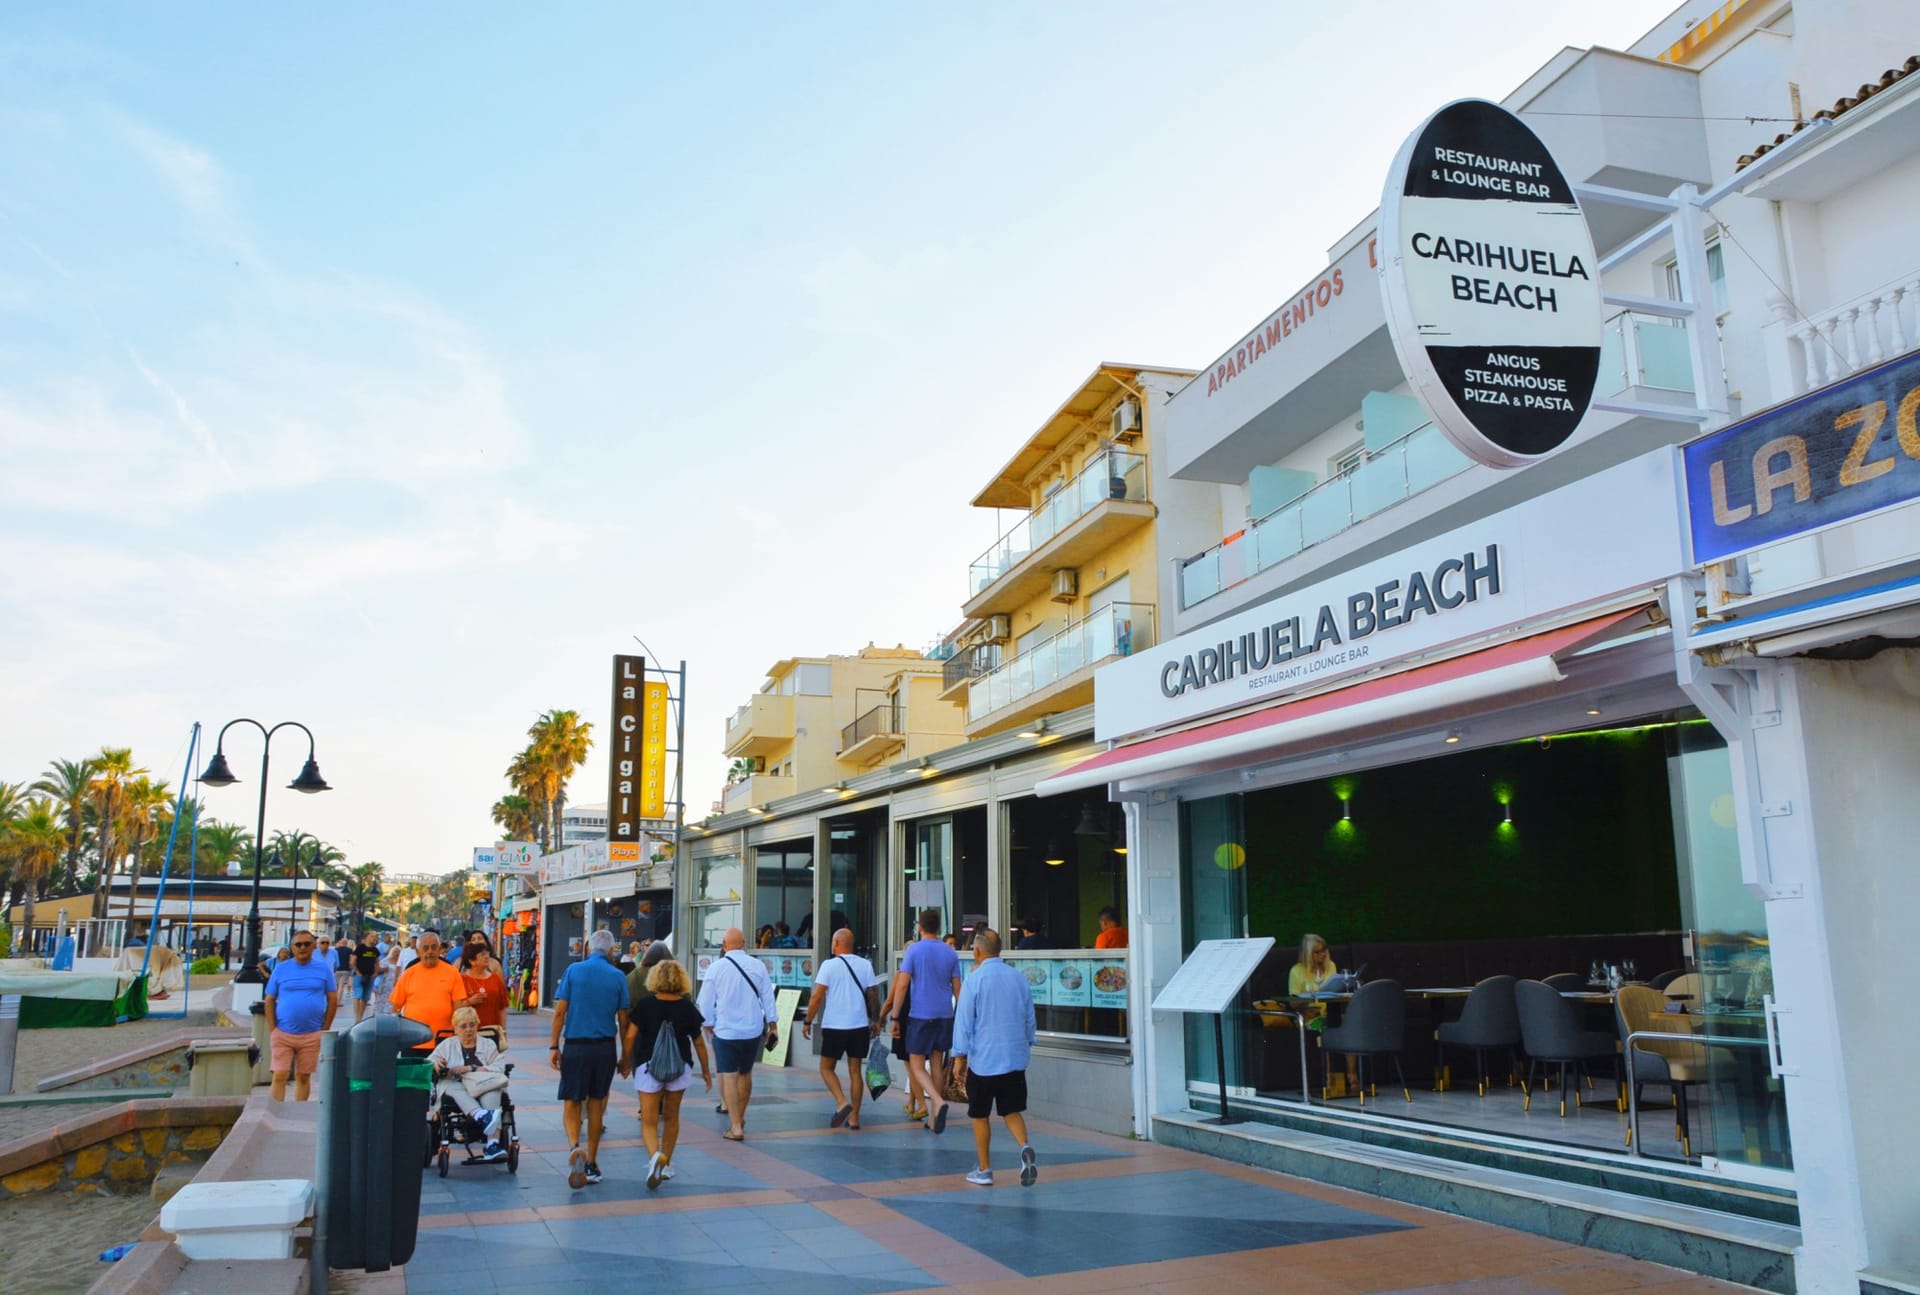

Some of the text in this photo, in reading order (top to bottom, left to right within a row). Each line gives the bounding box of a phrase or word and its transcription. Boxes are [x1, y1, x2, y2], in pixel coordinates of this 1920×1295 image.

[1434, 146, 1543, 178] RESTAURANT
[1431, 168, 1551, 198] & LOUNGE BAR
[1410, 232, 1590, 281] CARIHUELA
[1450, 274, 1558, 313] BEACH
[1207, 268, 1344, 397] APARTAMENTOS
[1464, 369, 1567, 393] STEAKHOUSE
[1486, 352, 1541, 371] ANGUS
[1464, 387, 1574, 412] PIZZA & PASTA
[1709, 434, 1812, 527] LA
[1160, 543, 1502, 699] CARIHUELA BEACH
[1248, 666, 1301, 690] RESTAURANT
[1309, 651, 1347, 673] LOUNGE
[1348, 645, 1369, 661] BAR
[617, 661, 637, 836] La Cigala
[612, 847, 636, 859] Playa
